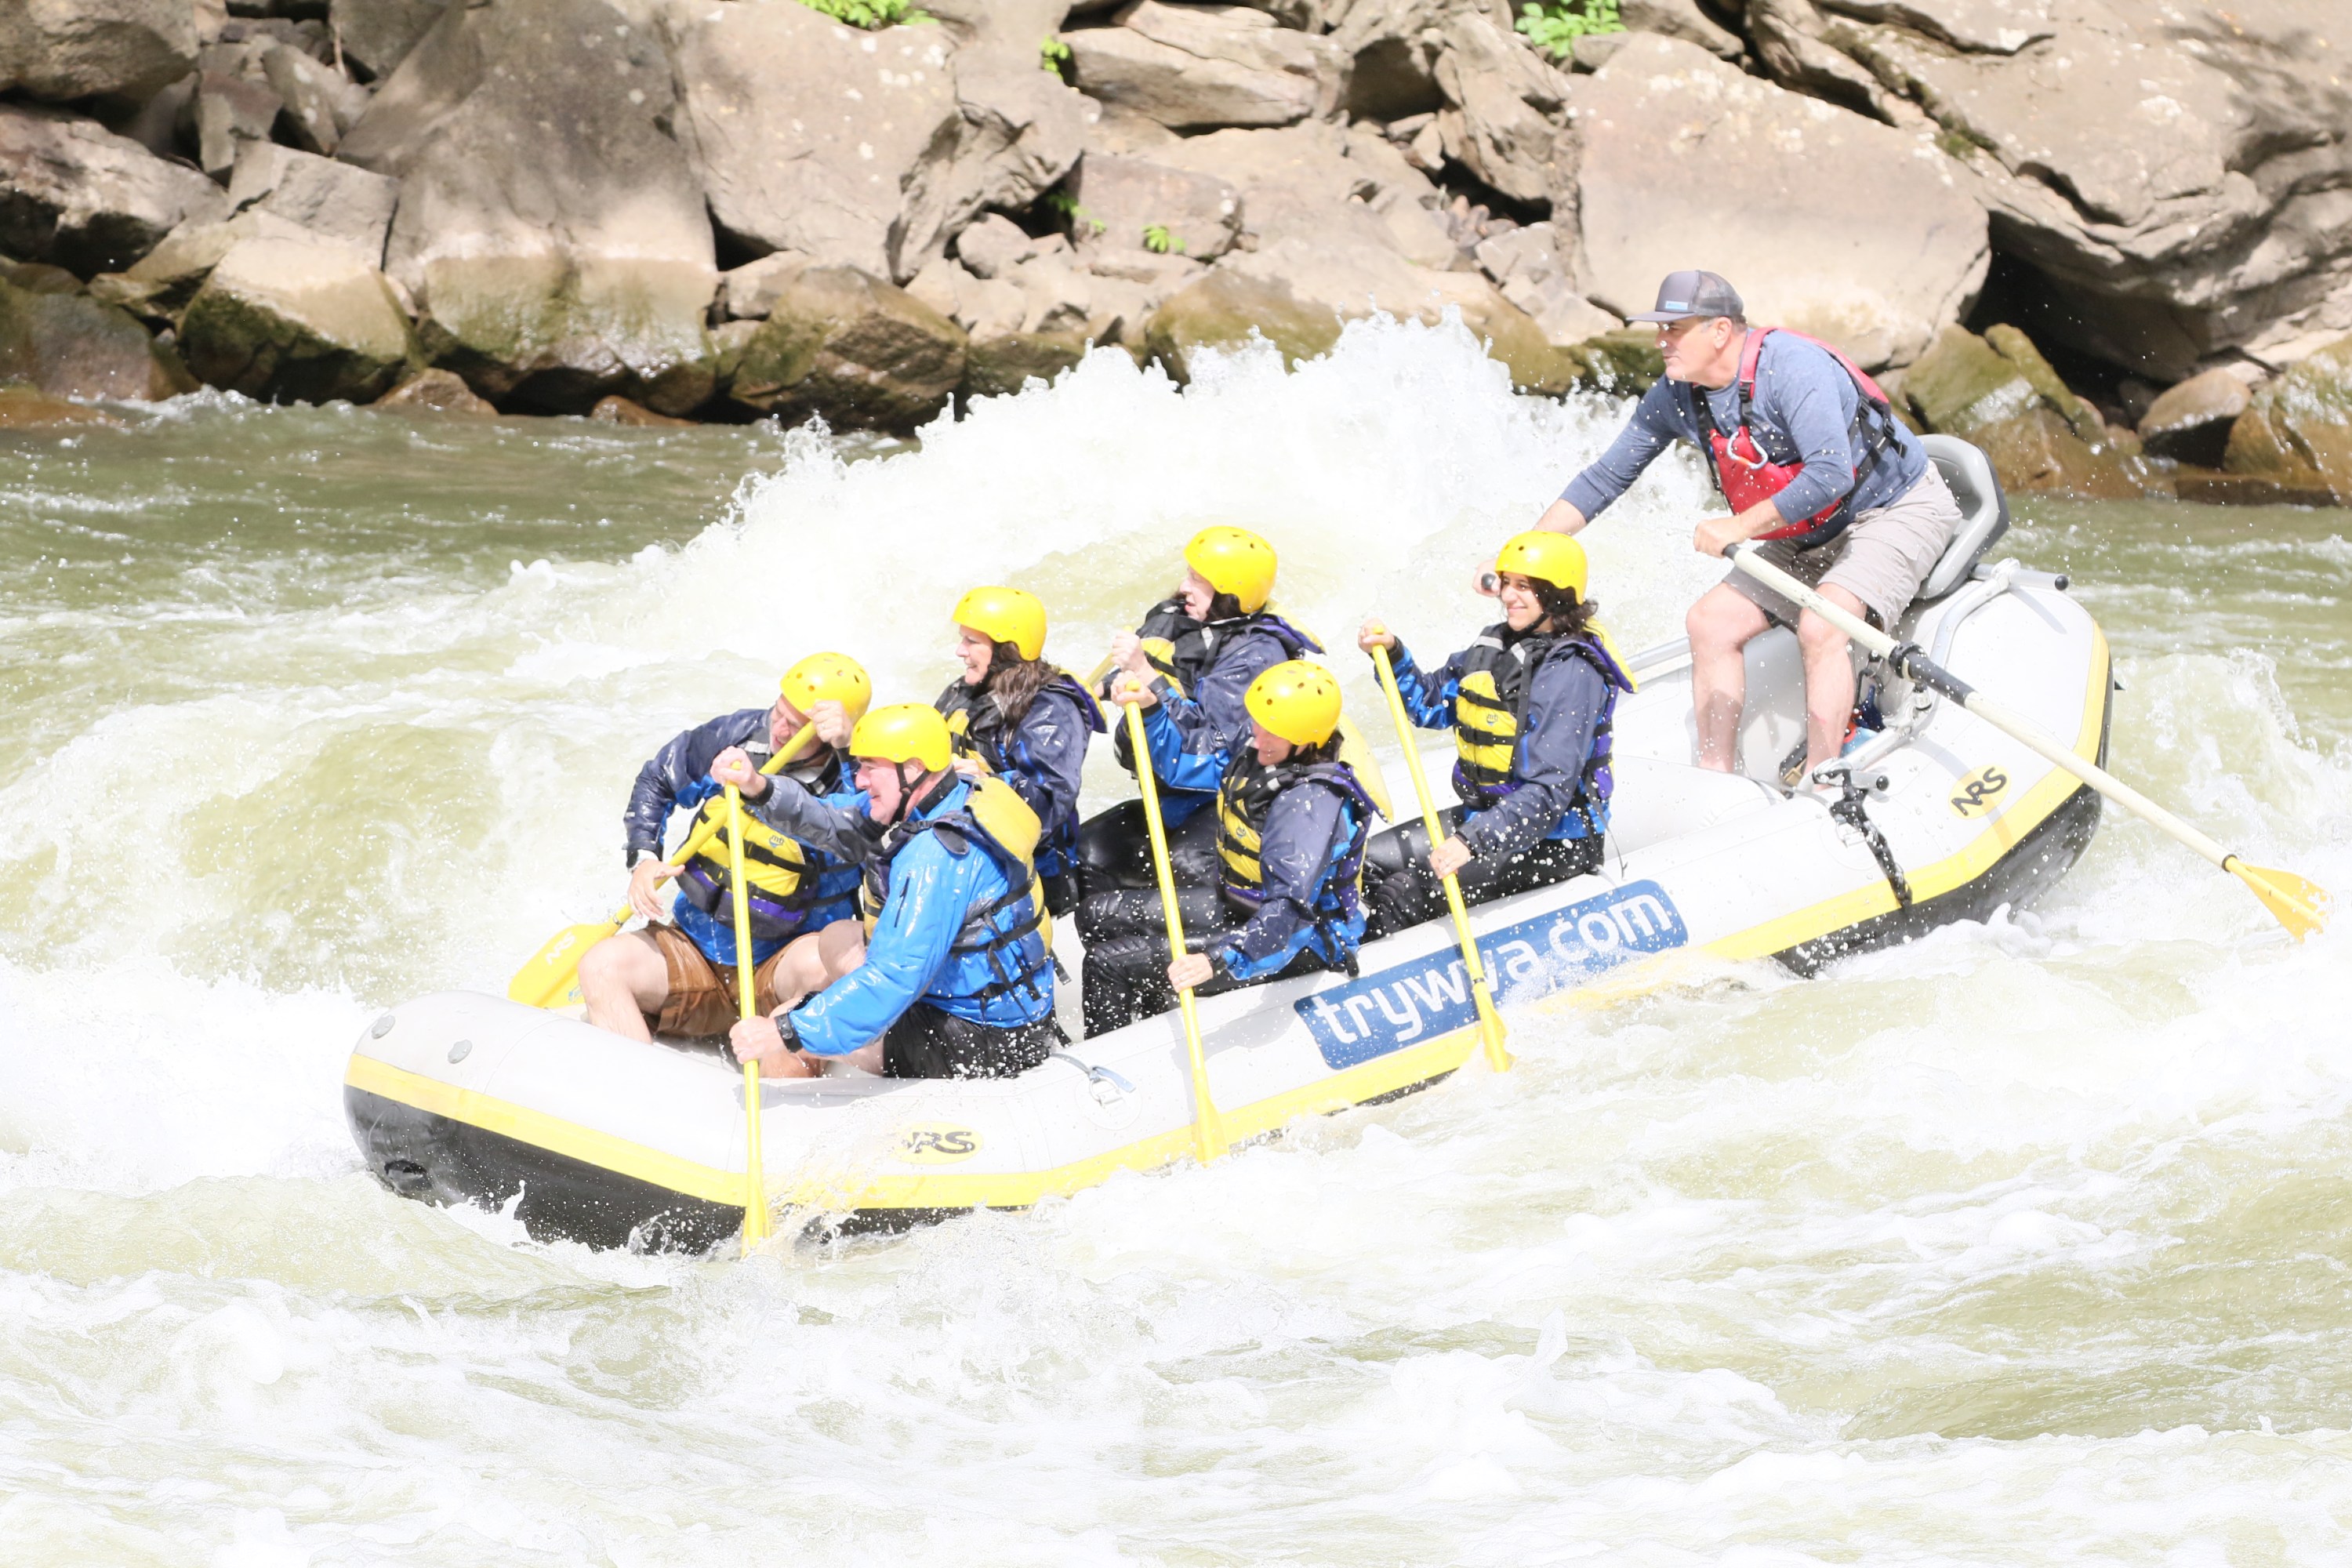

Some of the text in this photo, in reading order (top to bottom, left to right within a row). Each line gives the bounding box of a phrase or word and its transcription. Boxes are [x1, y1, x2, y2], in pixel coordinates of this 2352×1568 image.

[1951, 767, 2007, 816] NRS
[545, 931, 576, 966] NRS
[1312, 894, 1672, 1043] trywvacom
